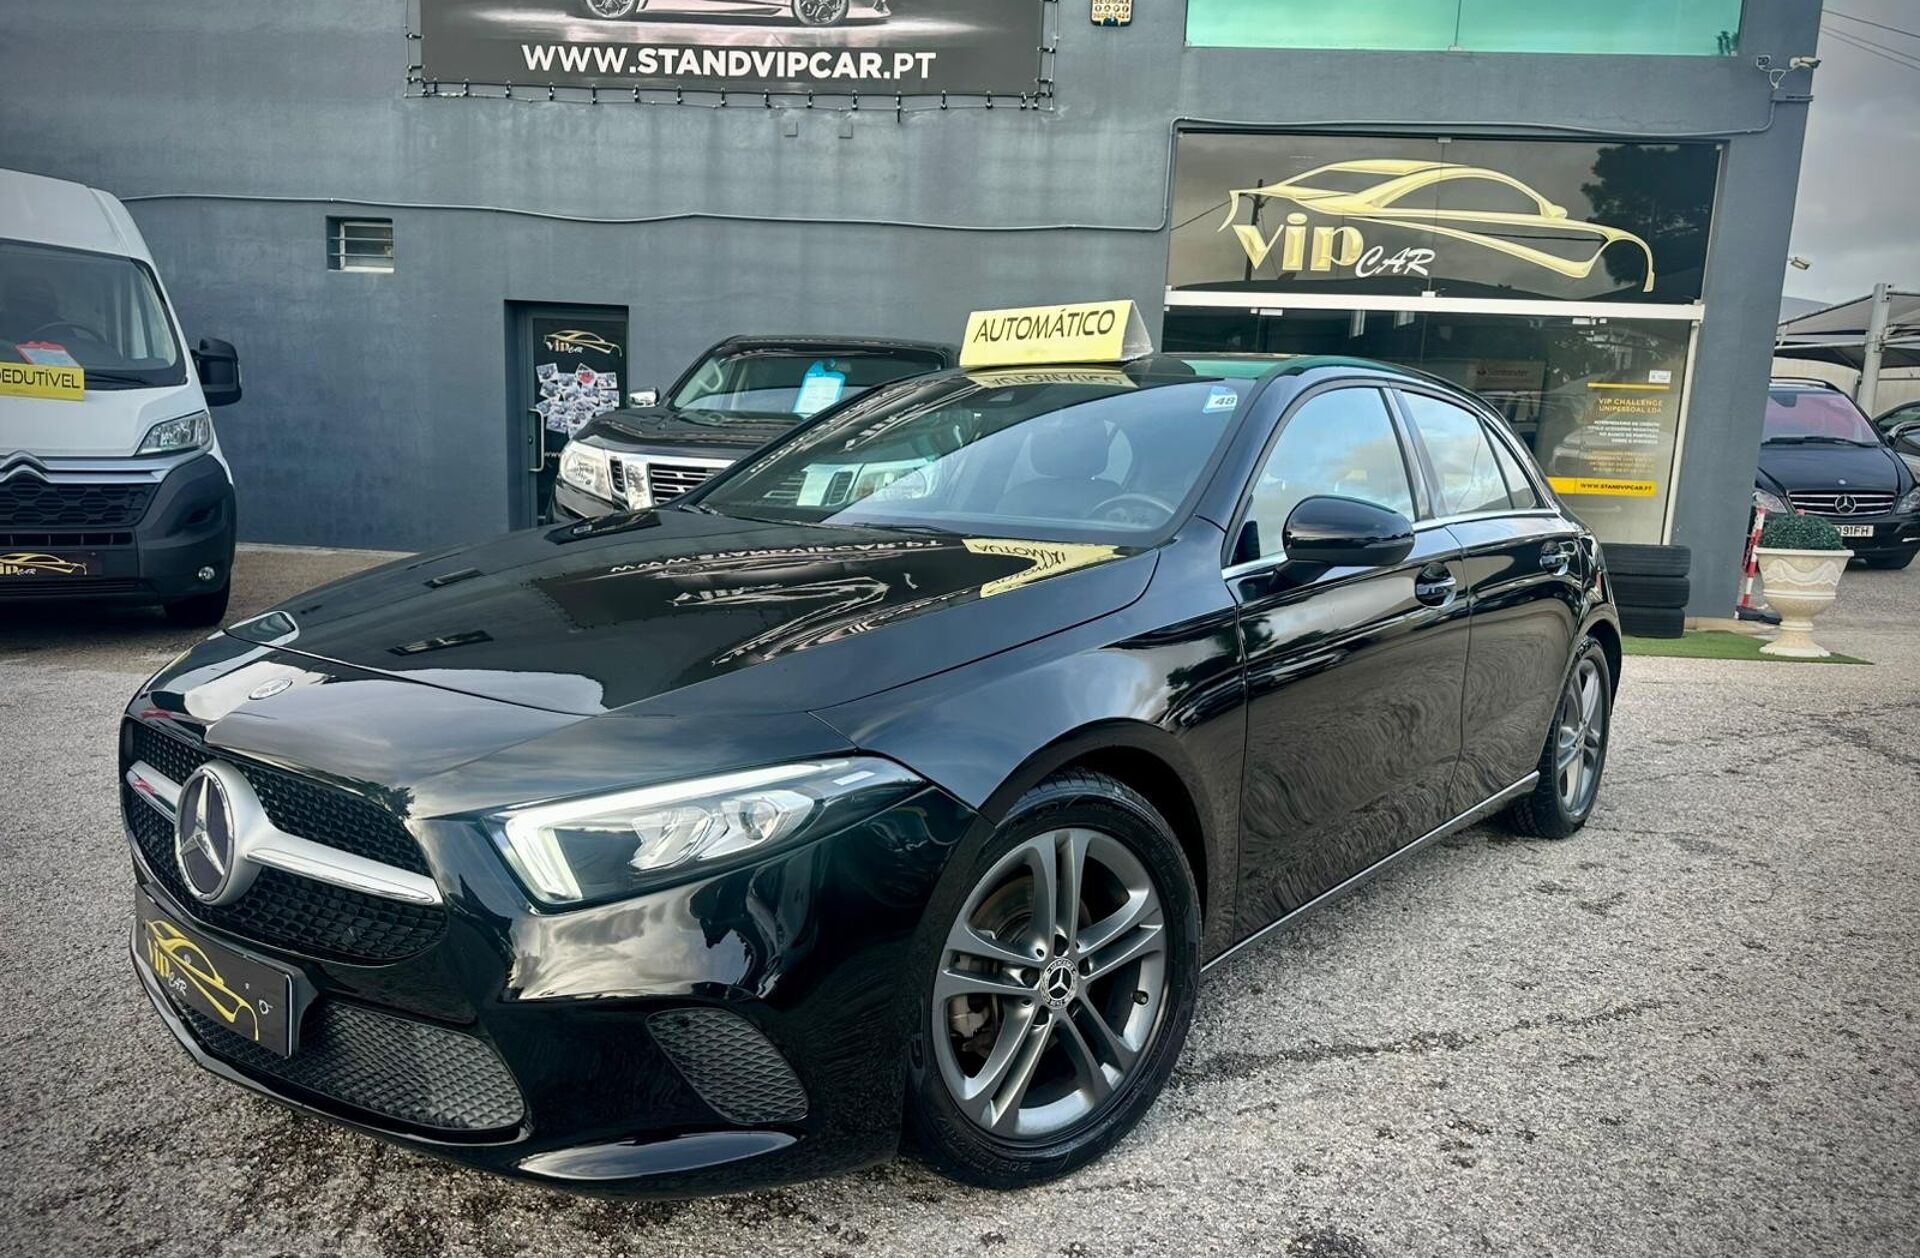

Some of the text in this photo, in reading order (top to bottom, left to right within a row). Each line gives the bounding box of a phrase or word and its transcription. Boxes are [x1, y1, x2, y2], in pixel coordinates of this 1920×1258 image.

[521, 44, 937, 80] WWW.STANDVIPCAR.PT
[1355, 245, 1436, 278] CAR
[973, 308, 1115, 343] AUTOMÁTICO
